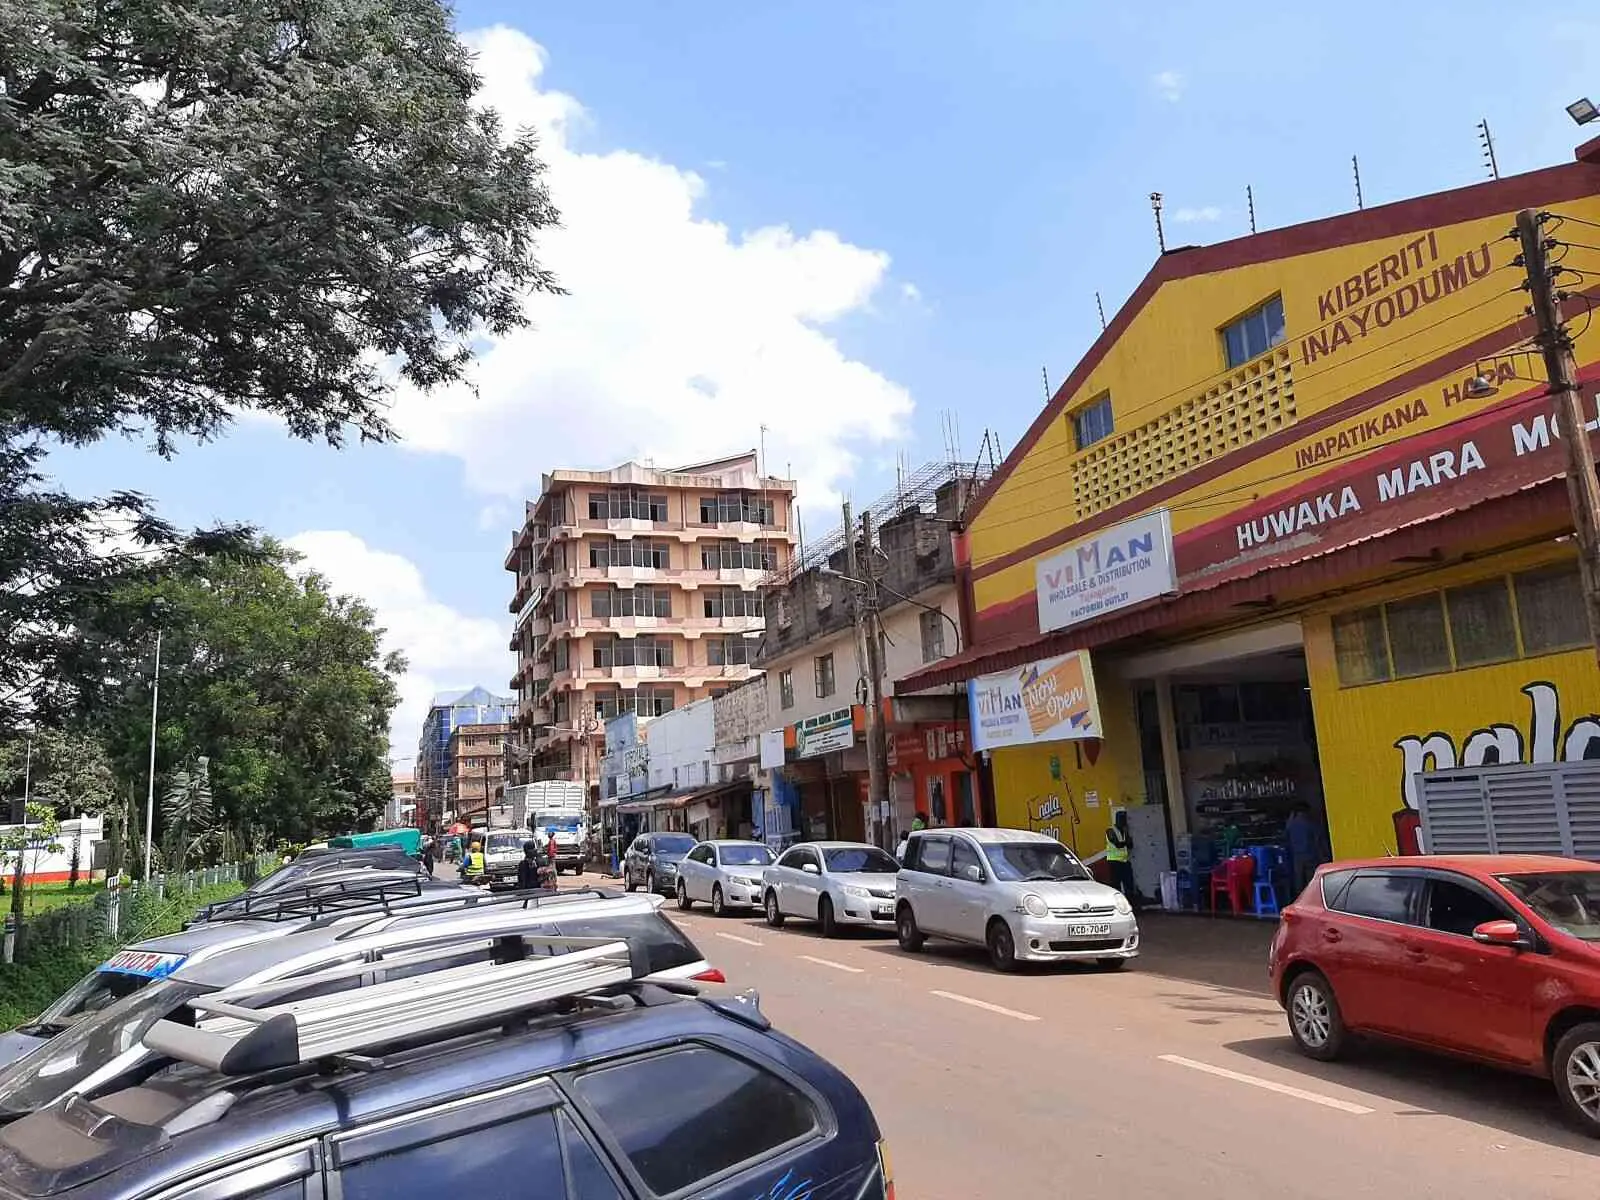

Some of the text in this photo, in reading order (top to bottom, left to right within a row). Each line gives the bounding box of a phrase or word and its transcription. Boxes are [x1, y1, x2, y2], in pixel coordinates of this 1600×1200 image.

[1301, 242, 1492, 365] INAYODUMU
[1318, 231, 1438, 321] KIBERITI
[1295, 399, 1430, 468] INAPATIKANA
[1236, 441, 1486, 549] HUWAKA MARA
[1044, 532, 1153, 589] VIMAN
[1049, 580, 1087, 604] WHOLESALE
[1089, 577, 1097, 588] &
[1099, 556, 1151, 585] DISTRIBUTION
[1047, 687, 1084, 721] Open
[1039, 794, 1060, 818] nala
